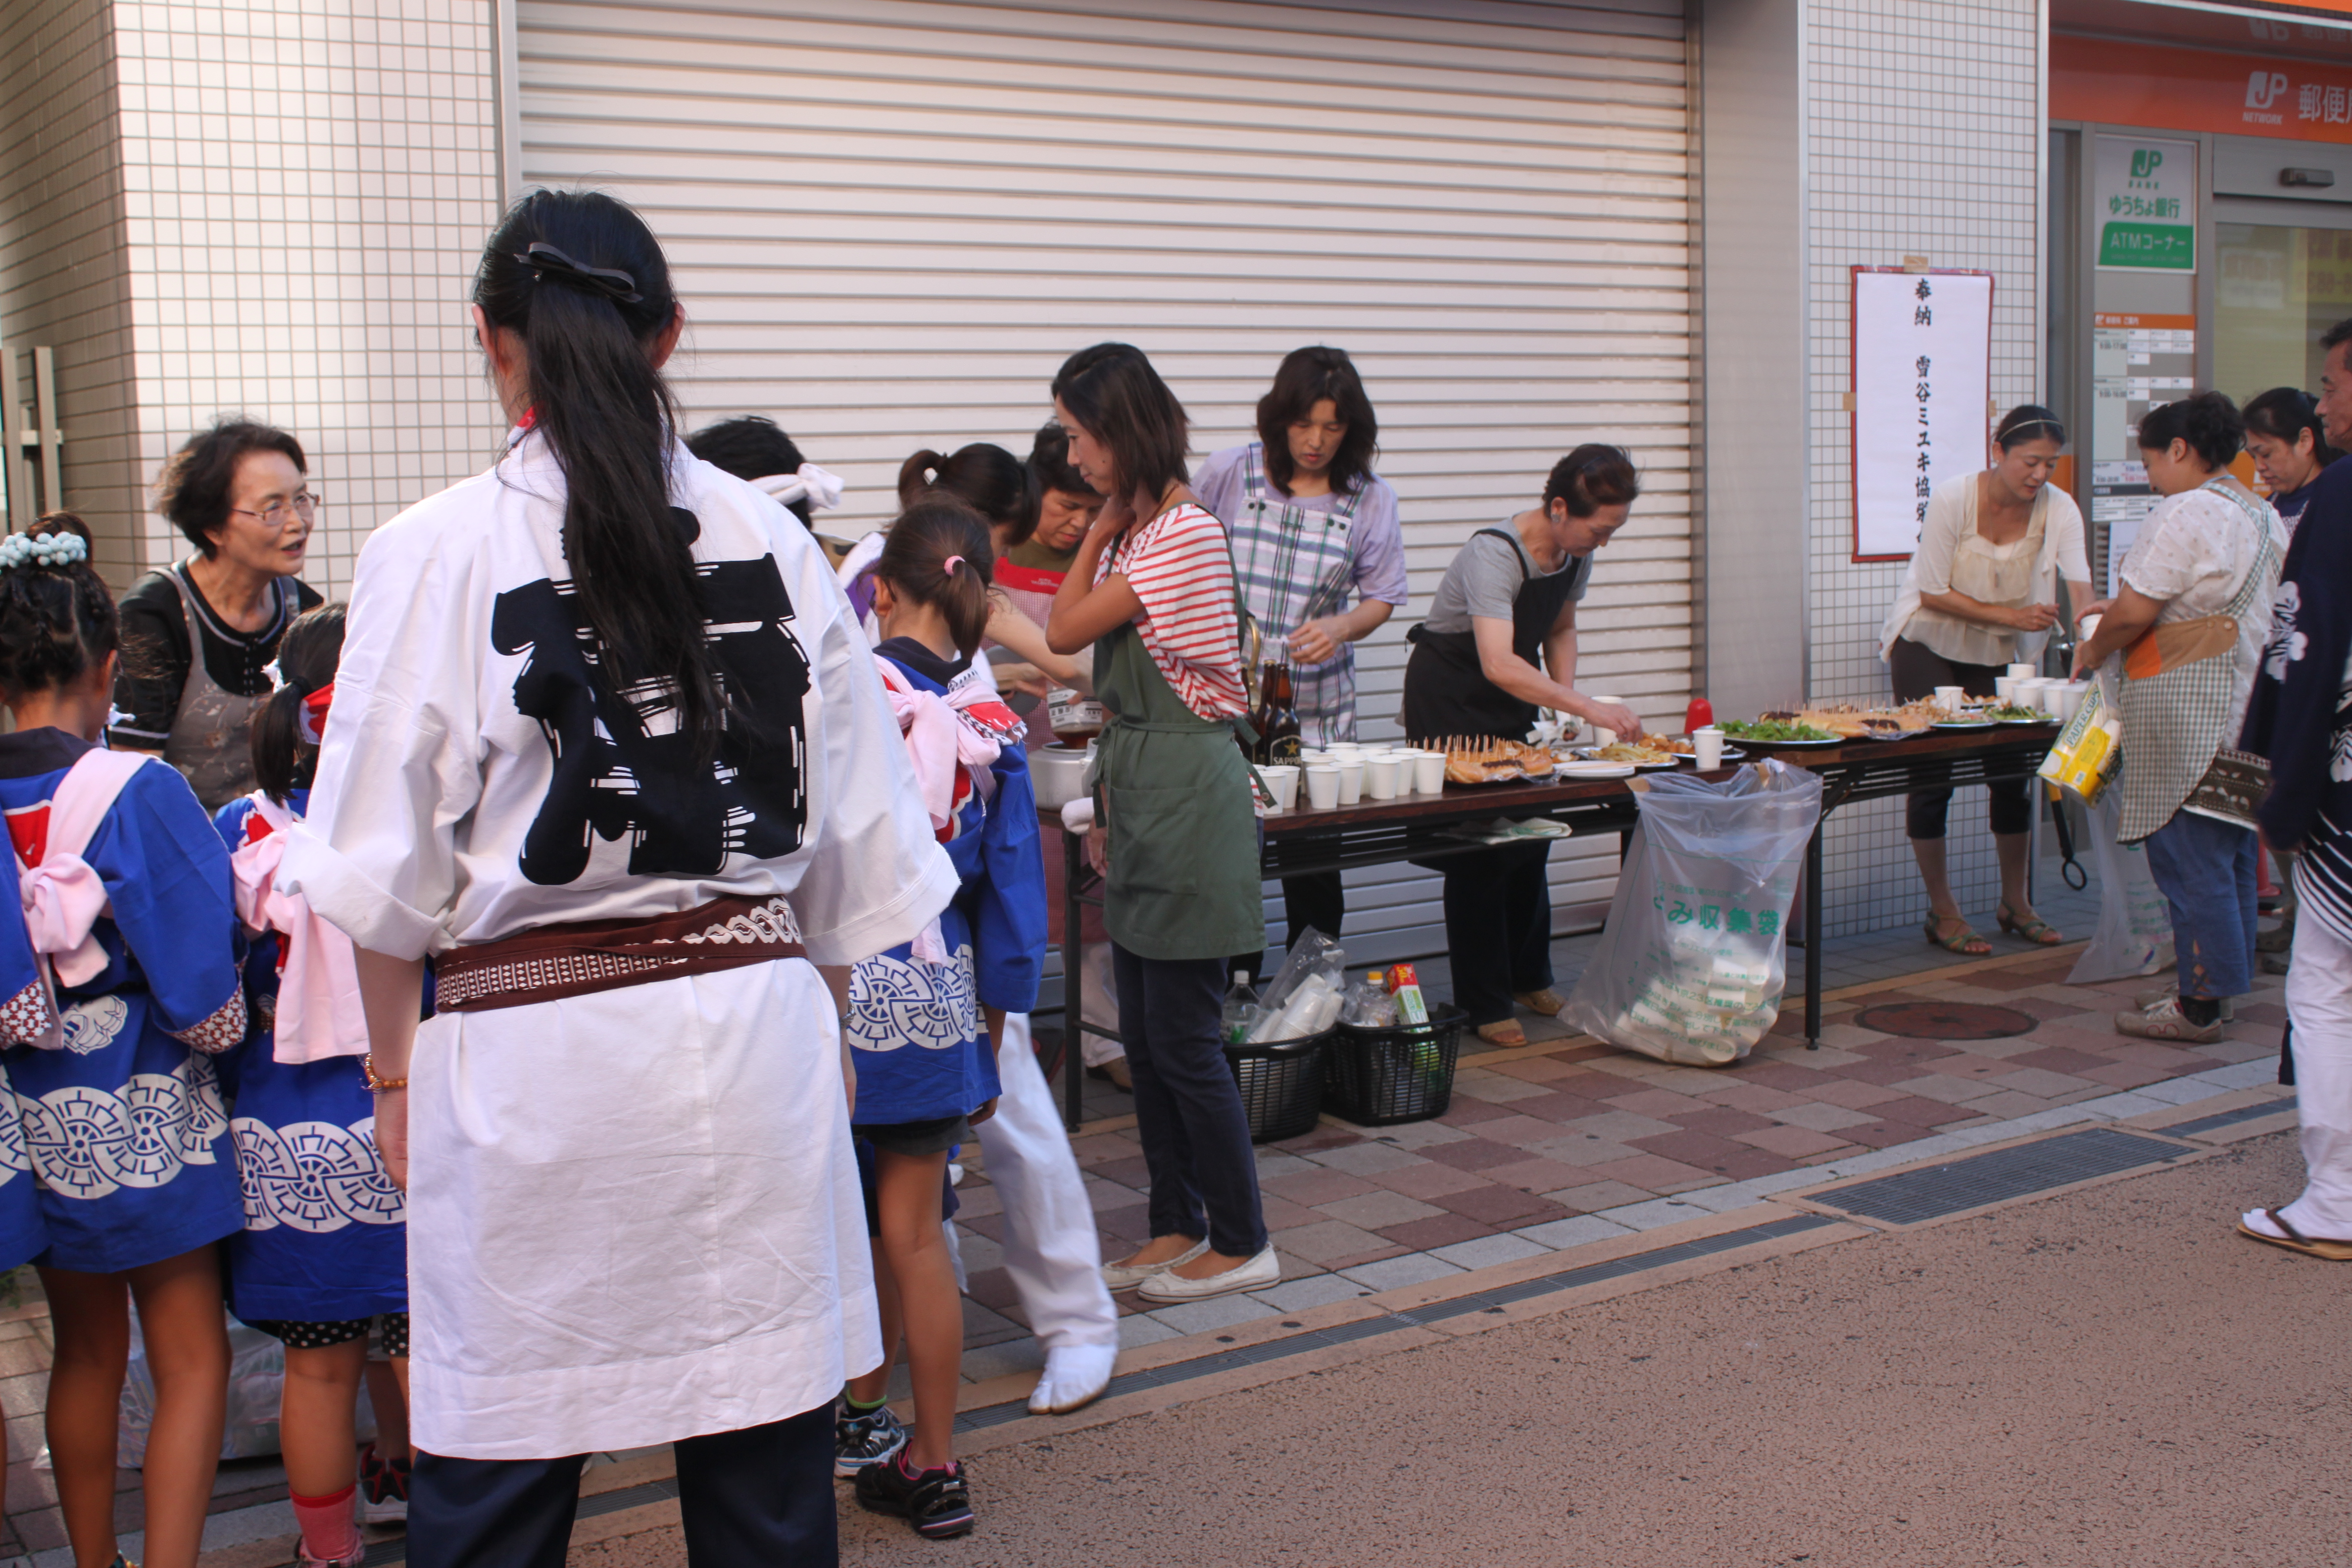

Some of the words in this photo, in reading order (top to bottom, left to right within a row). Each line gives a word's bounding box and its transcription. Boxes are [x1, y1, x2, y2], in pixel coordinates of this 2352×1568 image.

[2243, 112, 2283, 125] NETWORK
[2299, 83, 2352, 124] 郵便
[2109, 195, 2180, 218] ゆうちょ銀行
[2110, 232, 2186, 250] ATMコーナー
[1914, 278, 1932, 327] 奉納
[1915, 355, 1931, 543] 雪谷ミユキ協栄
[2065, 713, 2088, 746] PAPER
